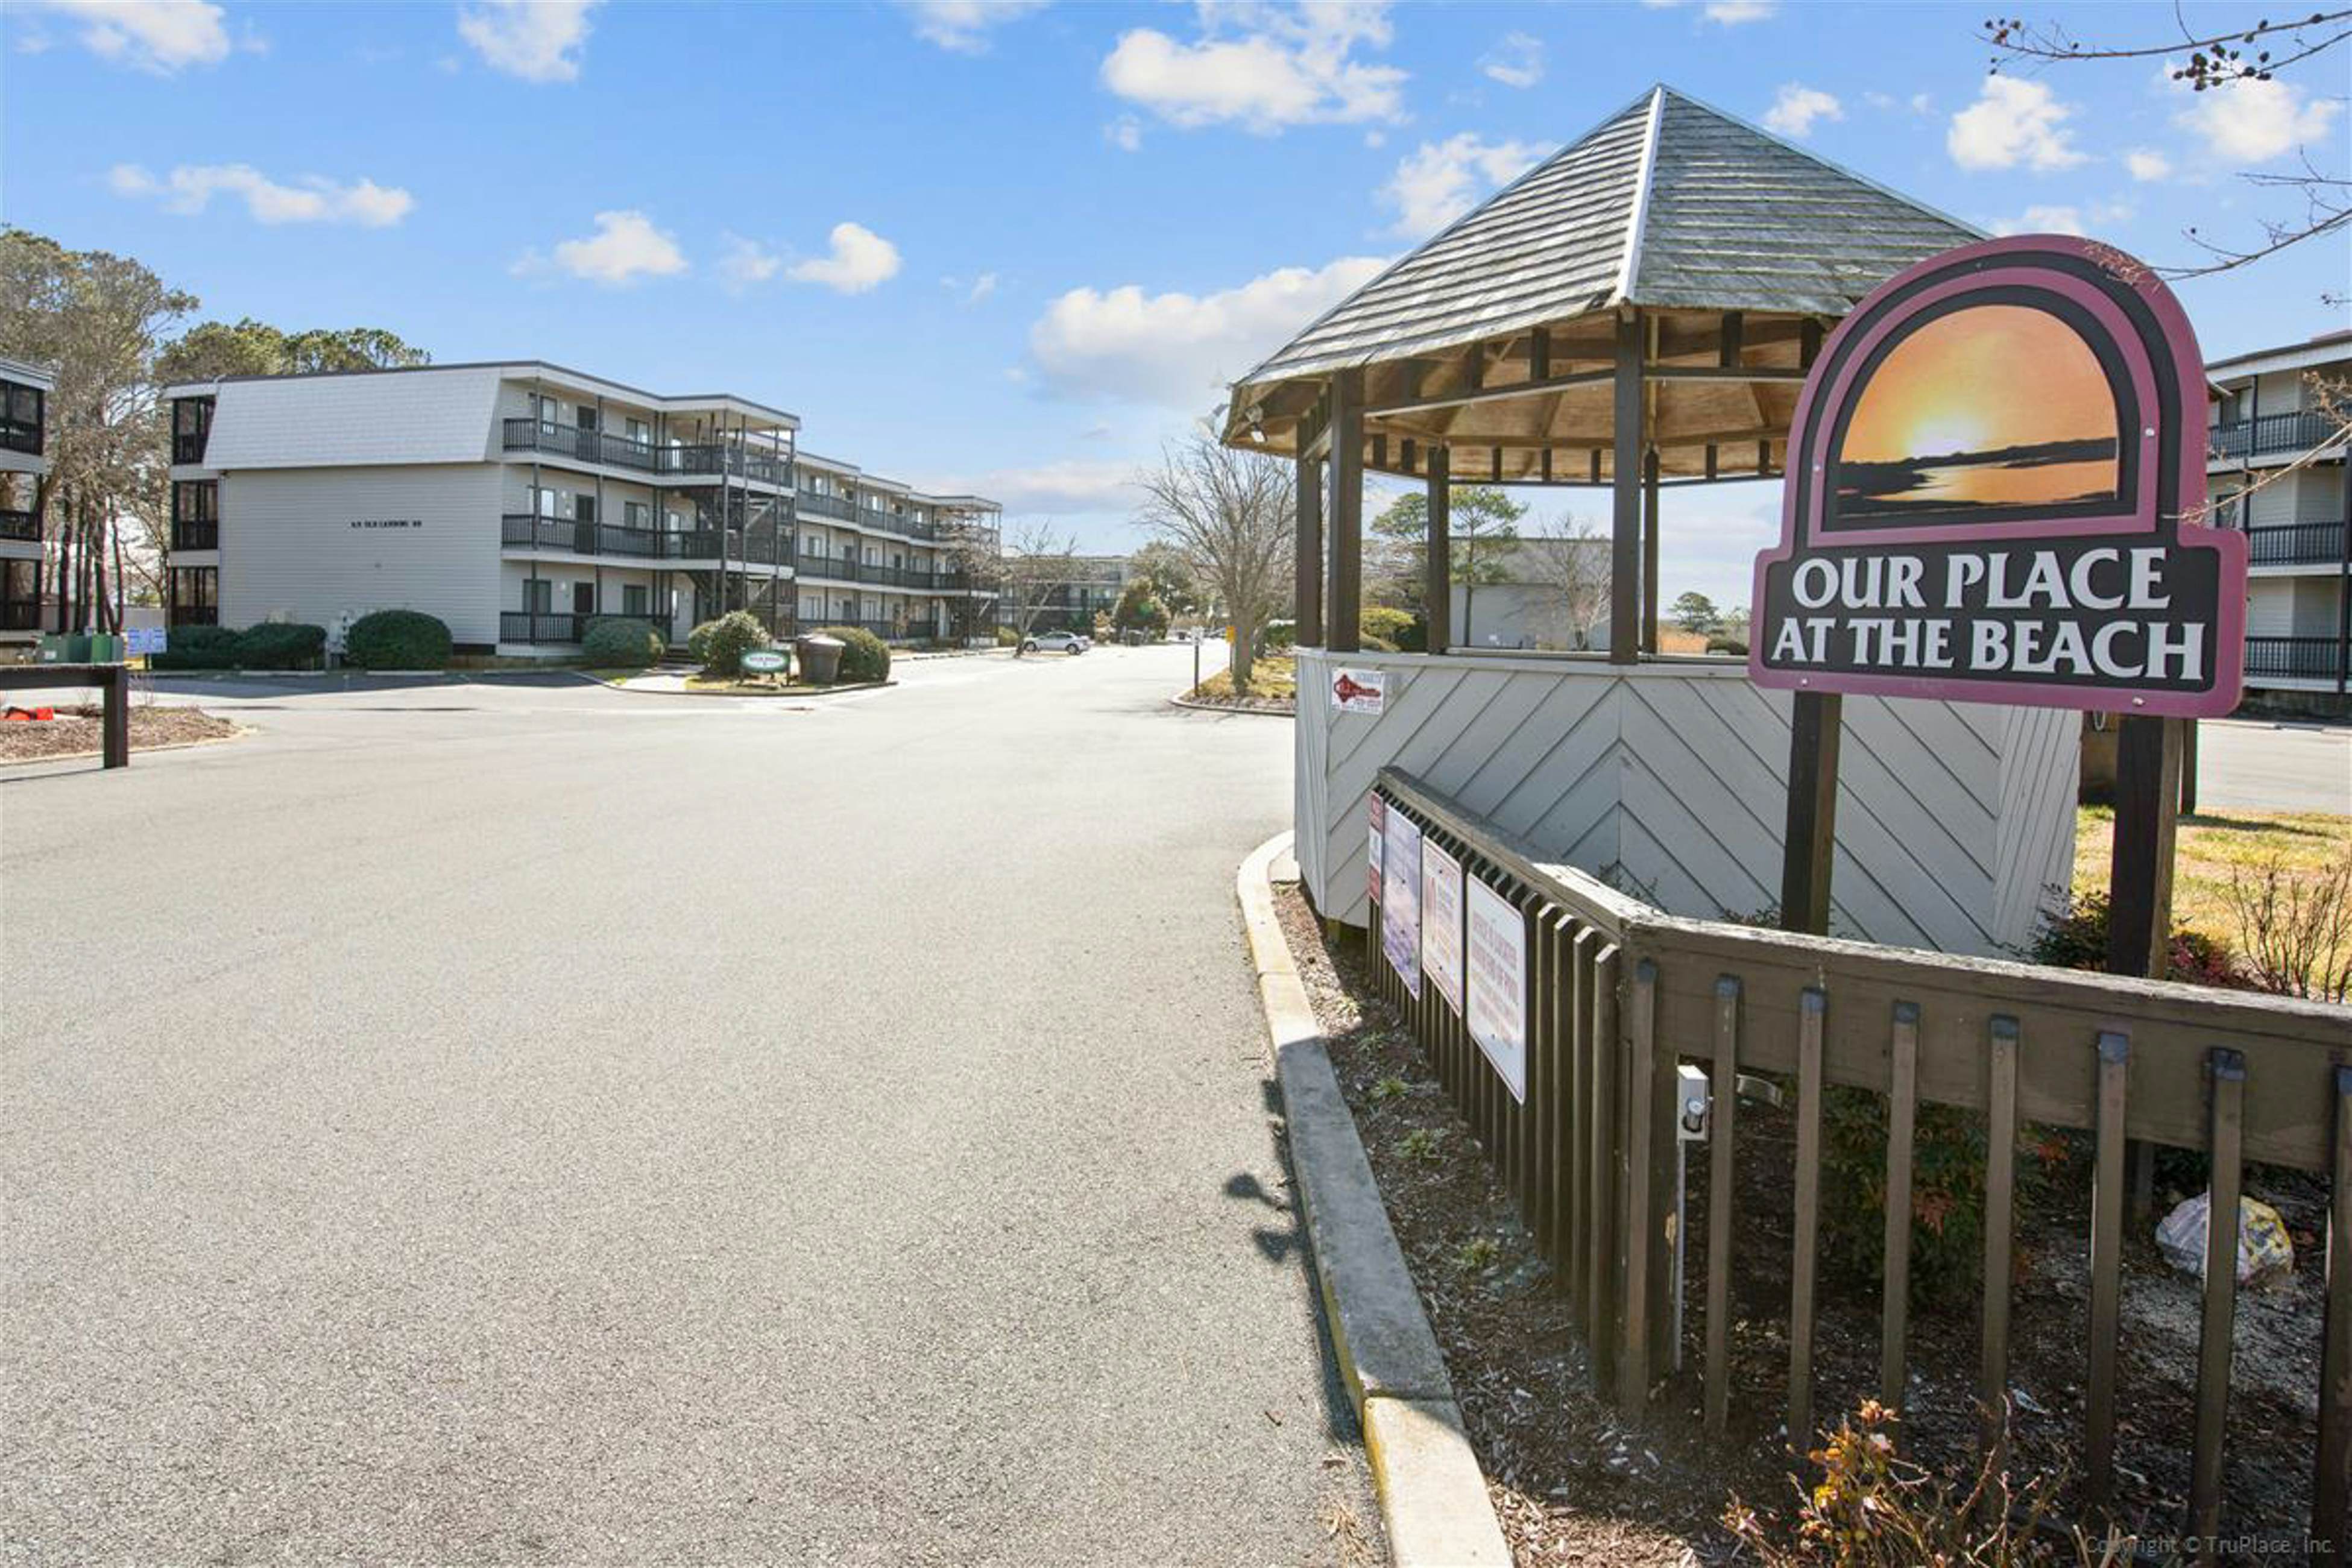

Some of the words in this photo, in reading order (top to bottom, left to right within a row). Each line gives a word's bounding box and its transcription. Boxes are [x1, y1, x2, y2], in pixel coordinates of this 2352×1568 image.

[1792, 556, 1927, 608] OUR
[1944, 547, 2171, 609] PLACE
[1771, 618, 1836, 663] AT
[1847, 619, 1953, 668] THE
[1970, 620, 2204, 680] BEACH
